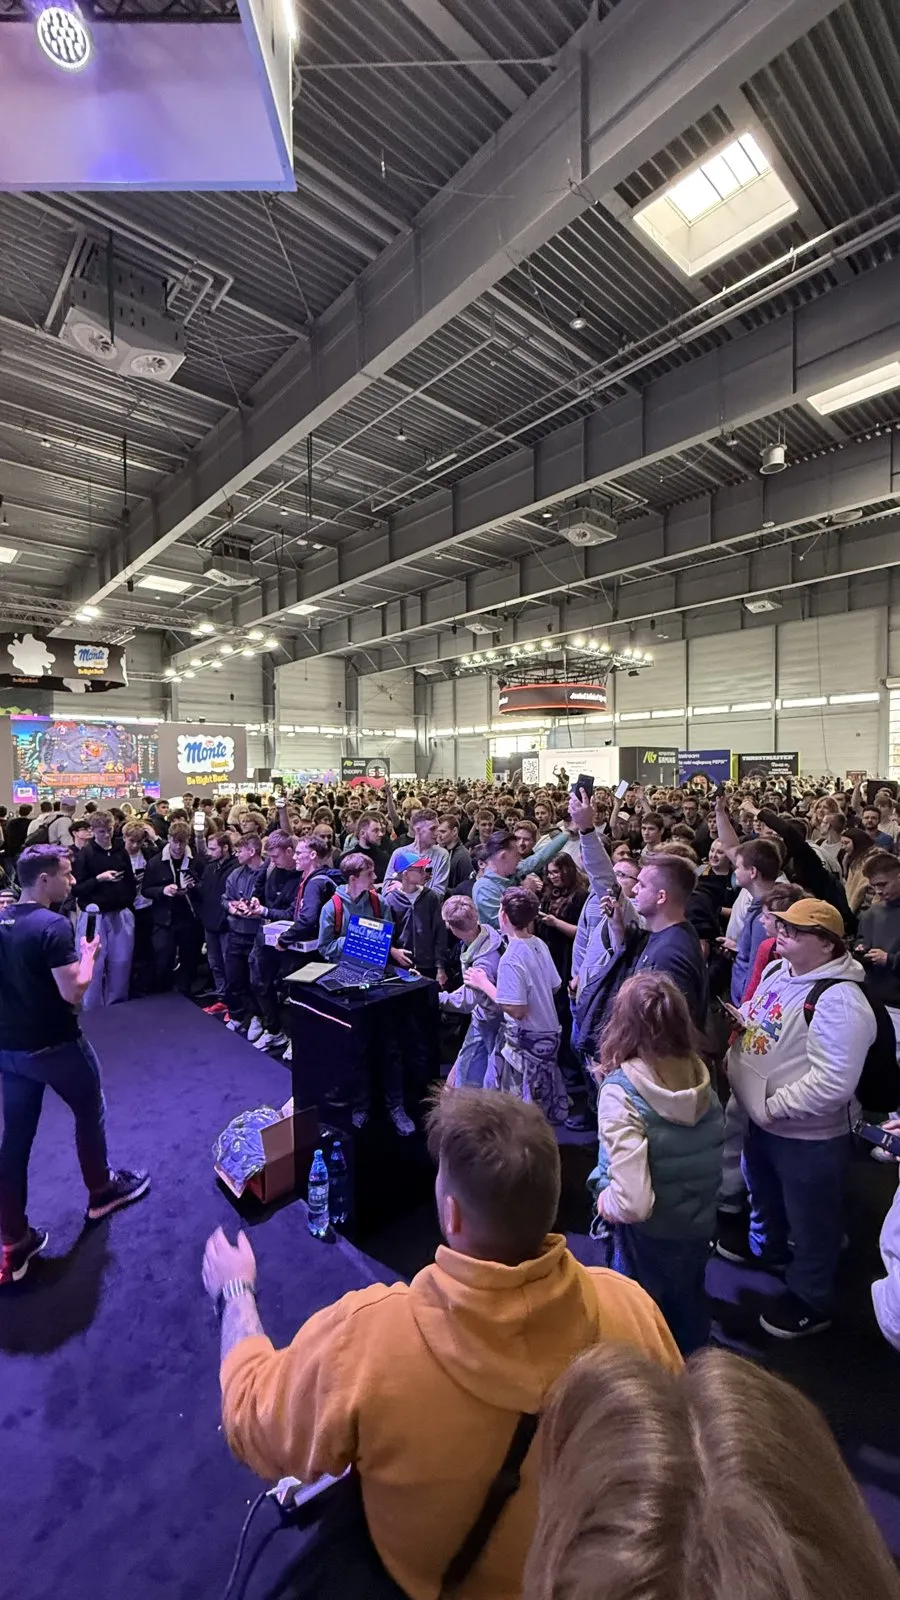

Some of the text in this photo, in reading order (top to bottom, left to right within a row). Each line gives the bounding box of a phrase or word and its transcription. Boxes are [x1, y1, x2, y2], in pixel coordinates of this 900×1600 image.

[78, 648, 104, 662] Monte
[184, 741, 227, 764] Monte
[186, 773, 229, 786] Be Right Back
